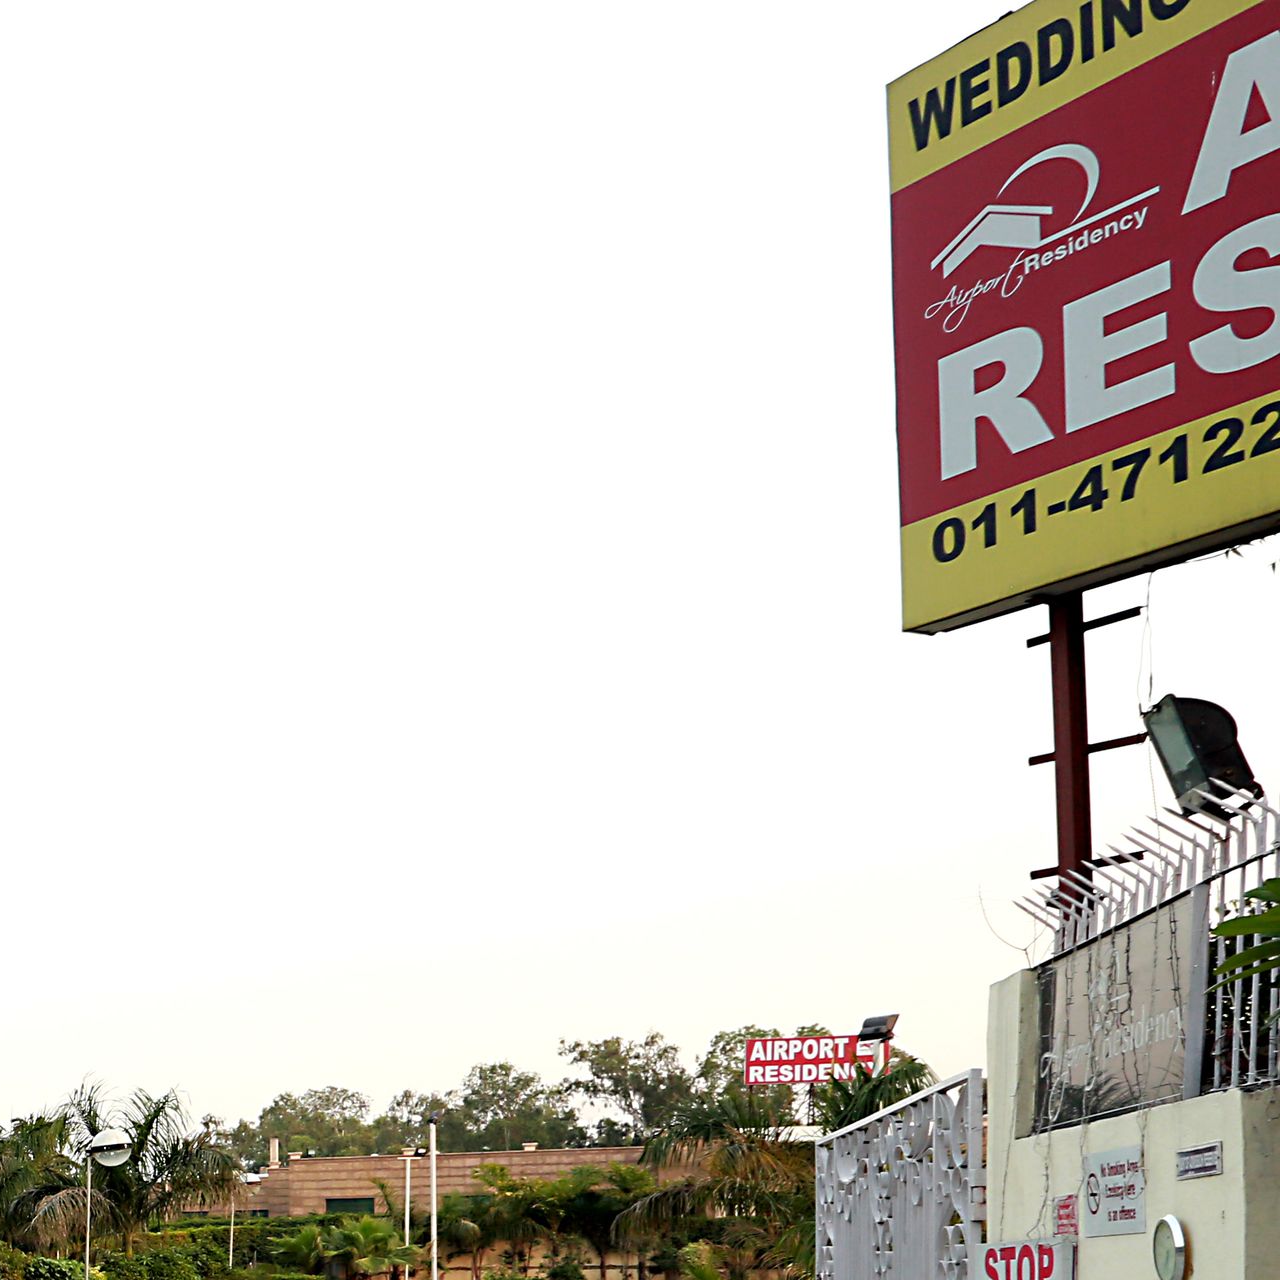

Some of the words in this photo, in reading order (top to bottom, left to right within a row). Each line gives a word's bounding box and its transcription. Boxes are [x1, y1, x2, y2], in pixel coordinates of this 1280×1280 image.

[924, 250, 1030, 332] Airport
[1023, 206, 1149, 276] Residency
[750, 1038, 849, 1061] AIRPORT
[749, 1062, 880, 1082] RESIDEN
